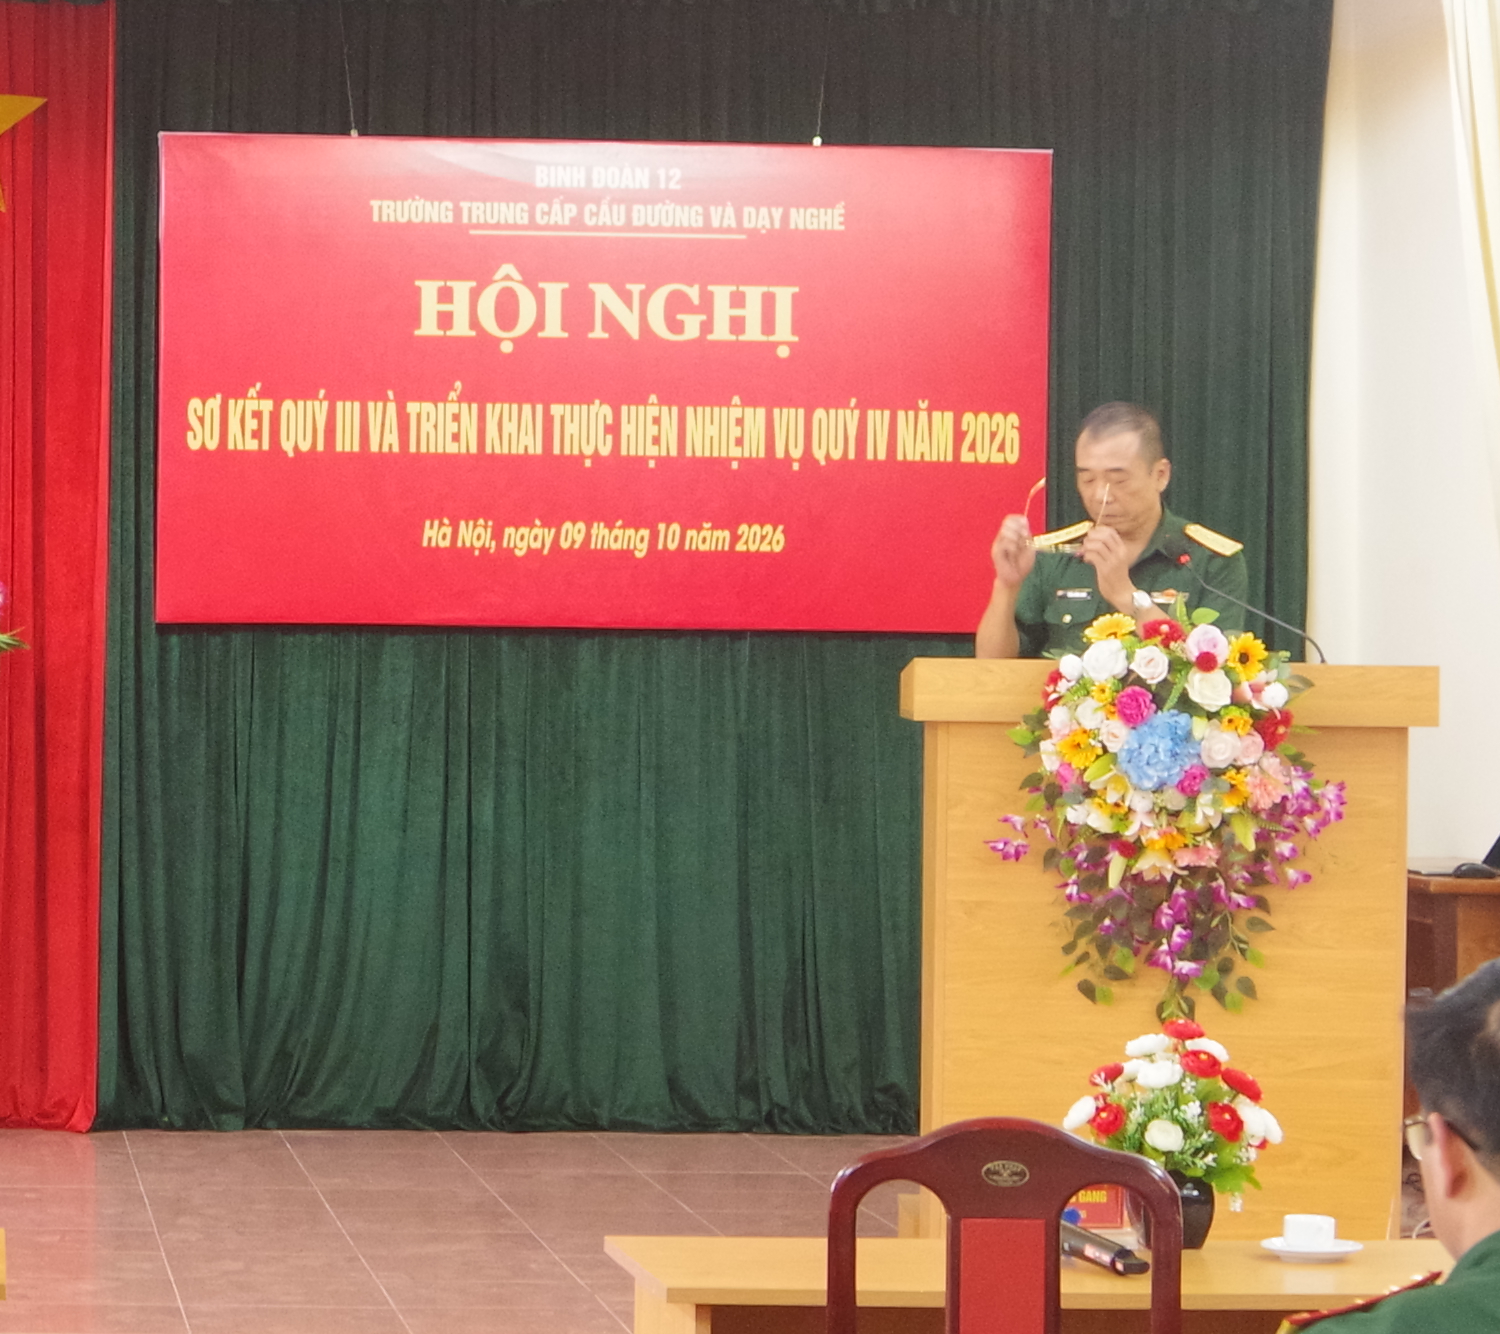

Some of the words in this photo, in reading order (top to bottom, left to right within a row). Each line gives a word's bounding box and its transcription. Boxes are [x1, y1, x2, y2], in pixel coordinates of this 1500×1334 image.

[534, 165, 586, 188] BINH
[591, 162, 650, 190] ĐOÀN
[657, 167, 682, 190] 12
[369, 194, 454, 224] TRƯỜNG
[459, 201, 529, 225] TRUNG
[534, 195, 577, 225] CẤP
[583, 196, 626, 226] CẦU
[631, 199, 704, 228] ĐƯỜNG
[709, 202, 737, 229] VÀ
[742, 206, 784, 234] DẠY
[789, 200, 846, 231] NGHỀ
[413, 262, 570, 354] HỘI
[587, 283, 800, 359] NGHỊ
[186, 394, 222, 451] SƠ
[227, 382, 274, 451] KẾT
[279, 388, 329, 458] QUÝ
[335, 400, 361, 453] III
[367, 389, 400, 453] VÀ
[406, 380, 479, 454] TRIỂN
[485, 402, 544, 455] KHAI
[549, 398, 614, 468] THỰC
[620, 393, 679, 469] HIỆN
[685, 395, 767, 470] NHIỆM
[772, 407, 805, 471] VỤ
[811, 397, 860, 466] QUÝ
[866, 409, 891, 461] IV
[896, 399, 954, 462] NĂM
[960, 411, 1020, 465] 2026
[422, 517, 452, 548] Hà
[457, 518, 497, 559] Nội,
[502, 518, 556, 557] ngày
[559, 521, 587, 550] 09
[590, 519, 650, 558] tháng
[657, 522, 681, 551] 10
[684, 522, 731, 551] năm
[735, 523, 785, 553] 2026
